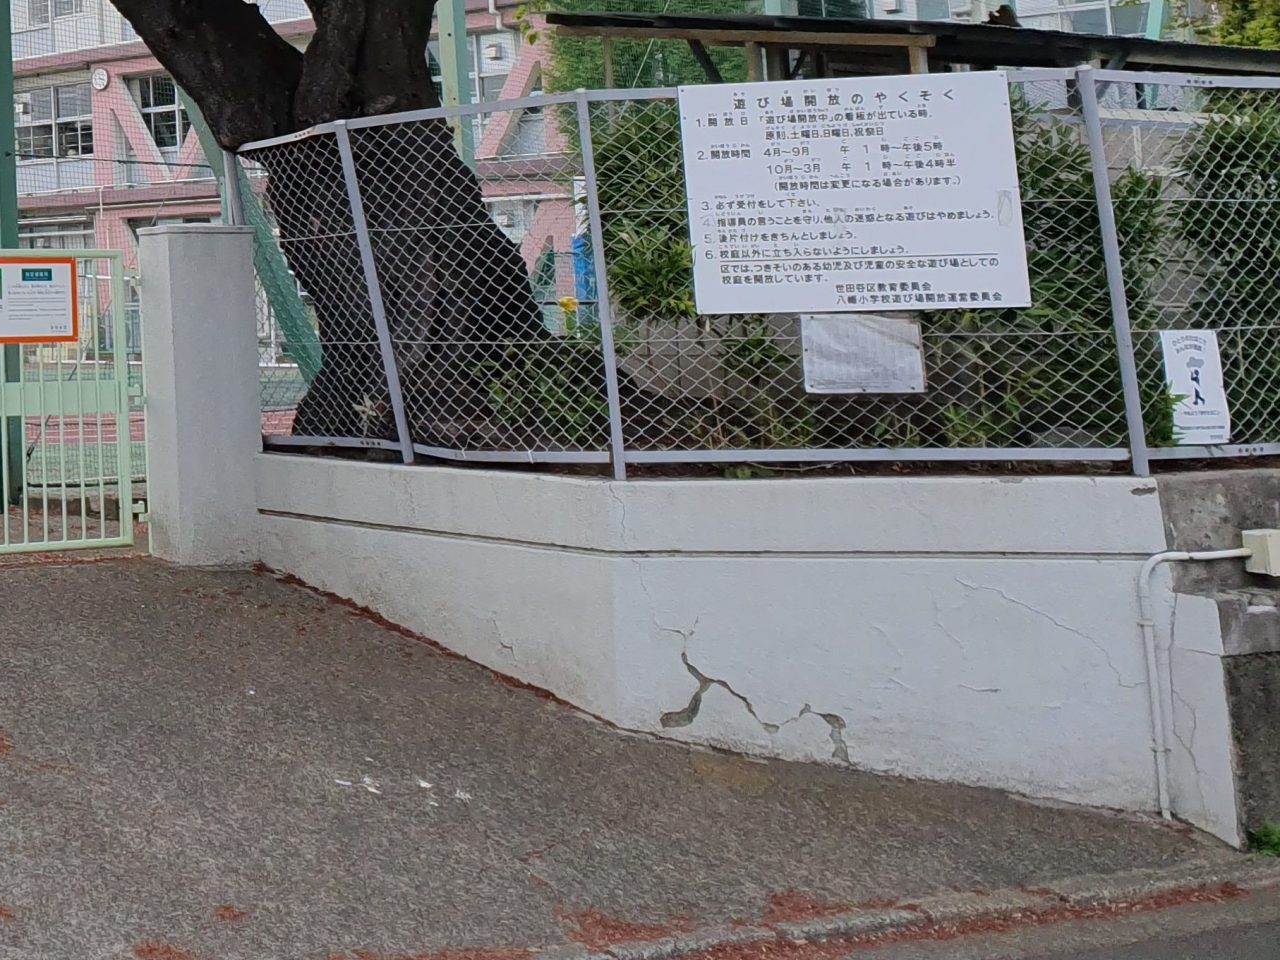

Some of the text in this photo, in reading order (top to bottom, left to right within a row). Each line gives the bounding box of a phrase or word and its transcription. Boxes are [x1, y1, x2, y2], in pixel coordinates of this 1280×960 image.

[734, 89, 954, 110] 遊び場開放のやくそく
[836, 282, 932, 293] 世田谷区教育委員会
